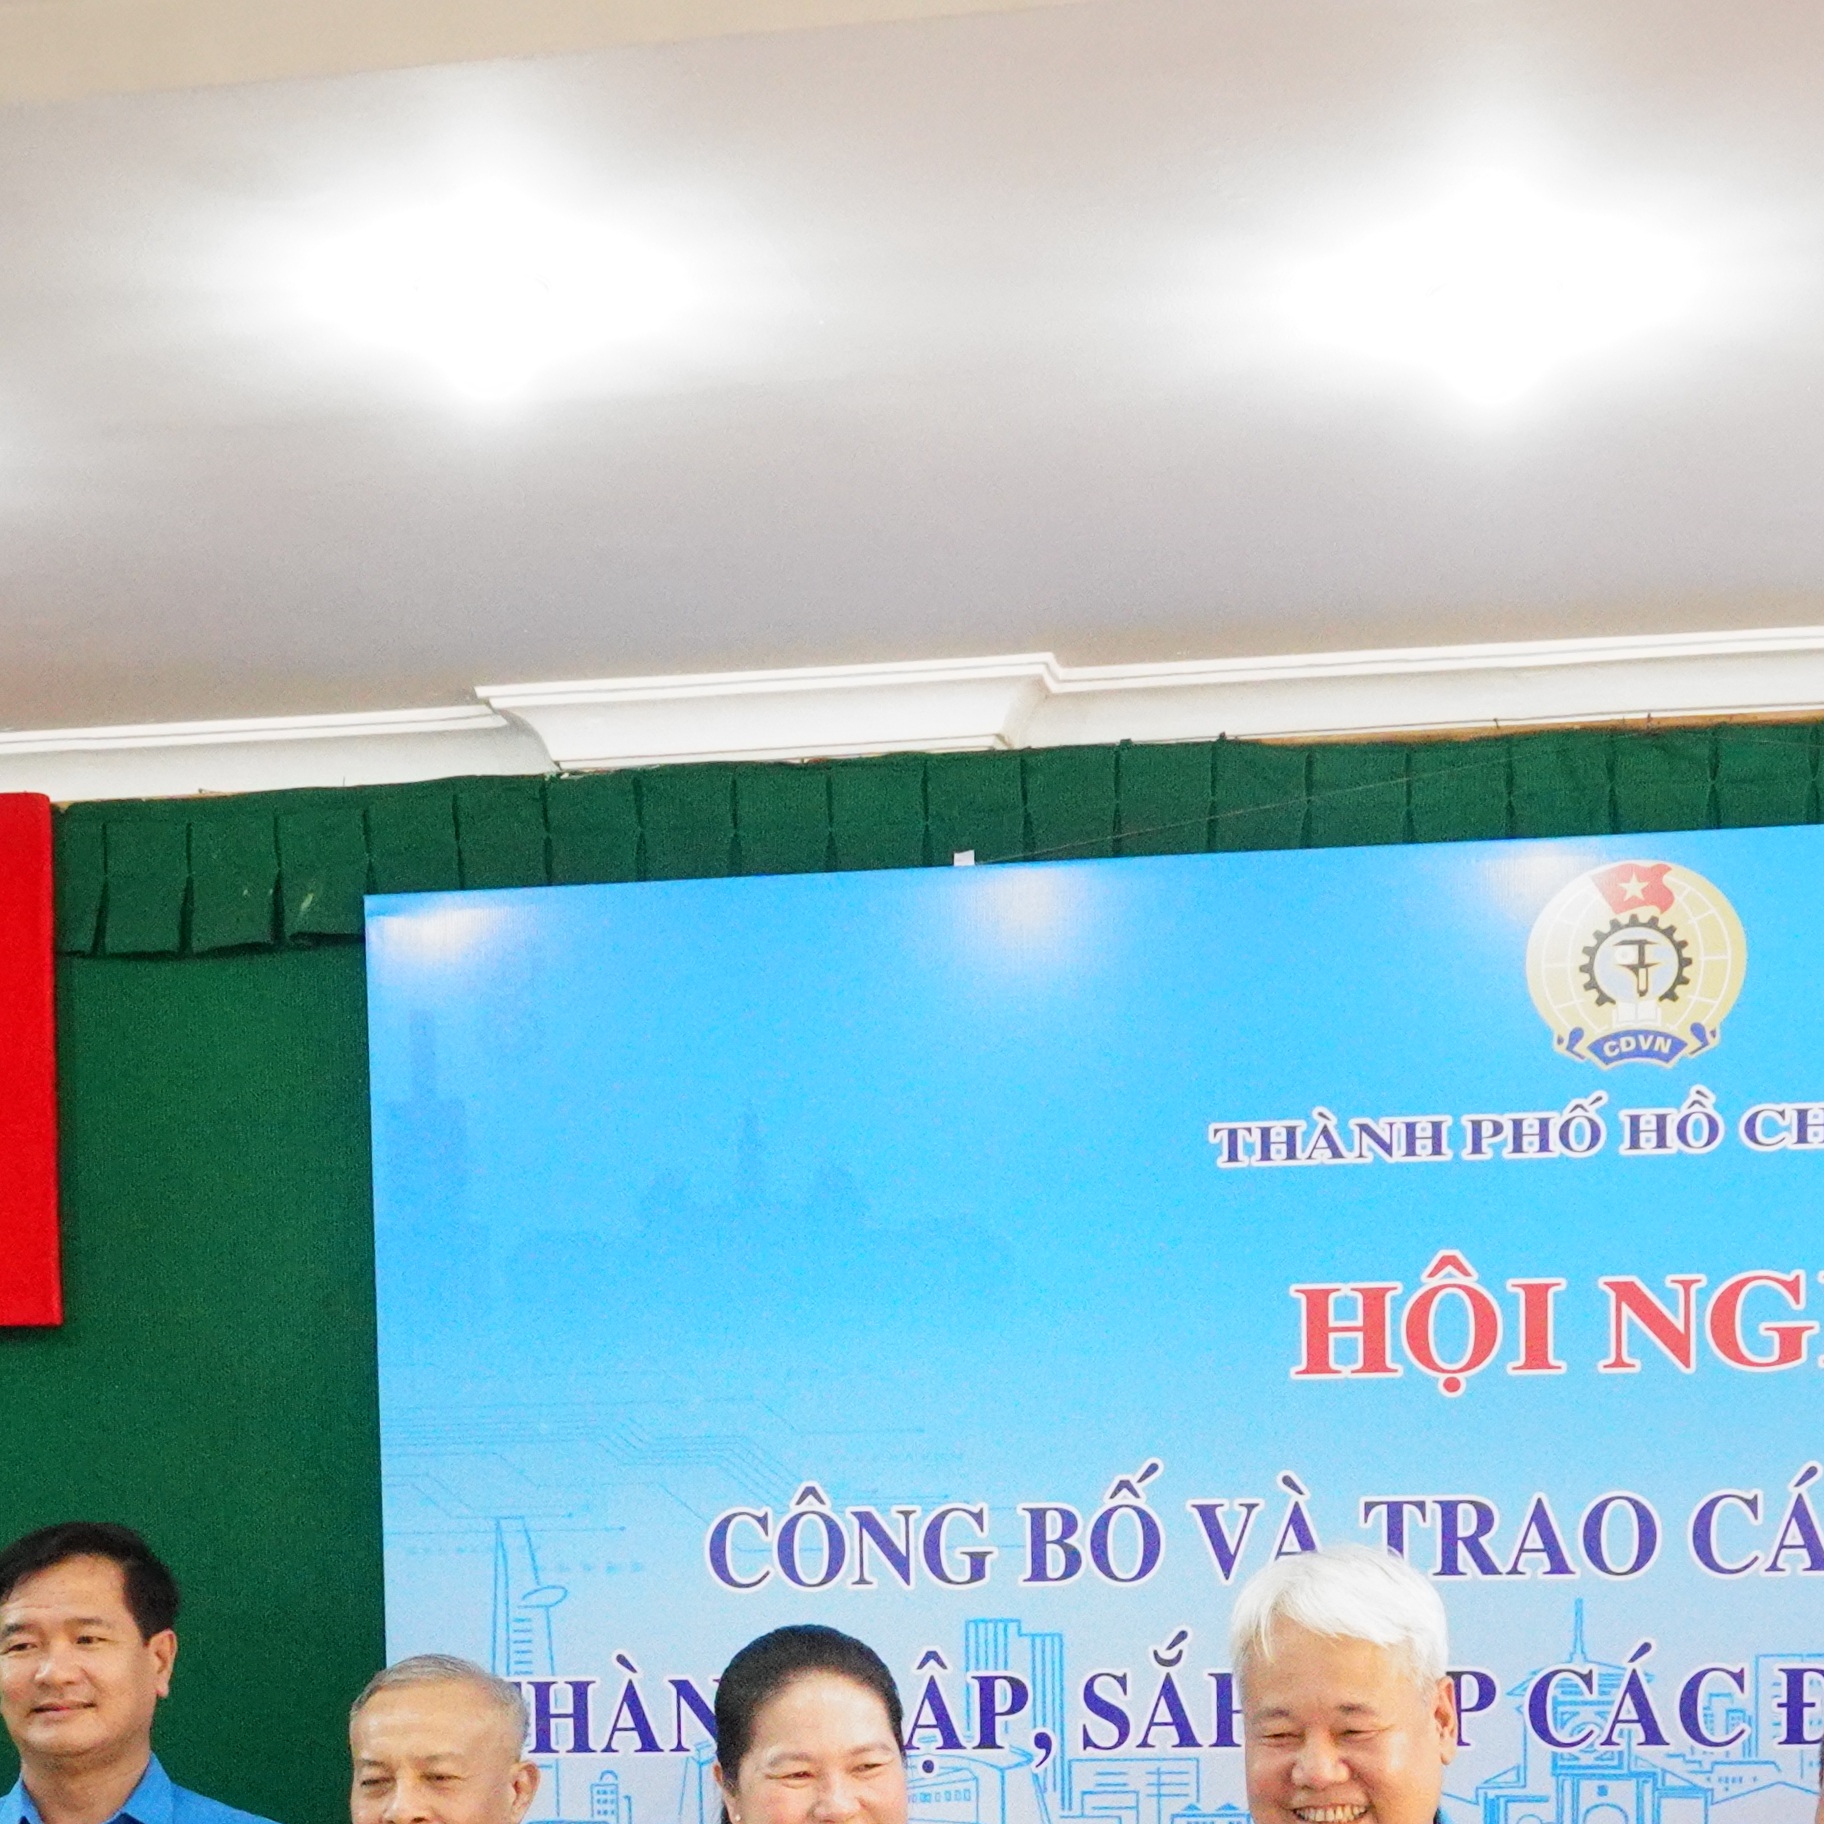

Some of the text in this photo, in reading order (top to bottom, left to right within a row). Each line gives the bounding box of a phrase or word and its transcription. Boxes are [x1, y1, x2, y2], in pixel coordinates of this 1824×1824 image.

[1212, 1107, 1446, 1164] THÀNH
[1463, 1093, 1607, 1158] PHỐ
[1622, 1087, 1720, 1153] HỒ
[1294, 1252, 1566, 1394] HỘI
[707, 1485, 993, 1589] CÔNG
[1020, 1461, 1164, 1585] BỐ
[1363, 1494, 1660, 1580] TRAO
[519, 1653, 719, 1754] HÀN
[903, 1649, 1055, 1775] ẬP,
[1526, 1641, 1747, 1750] CÁC
